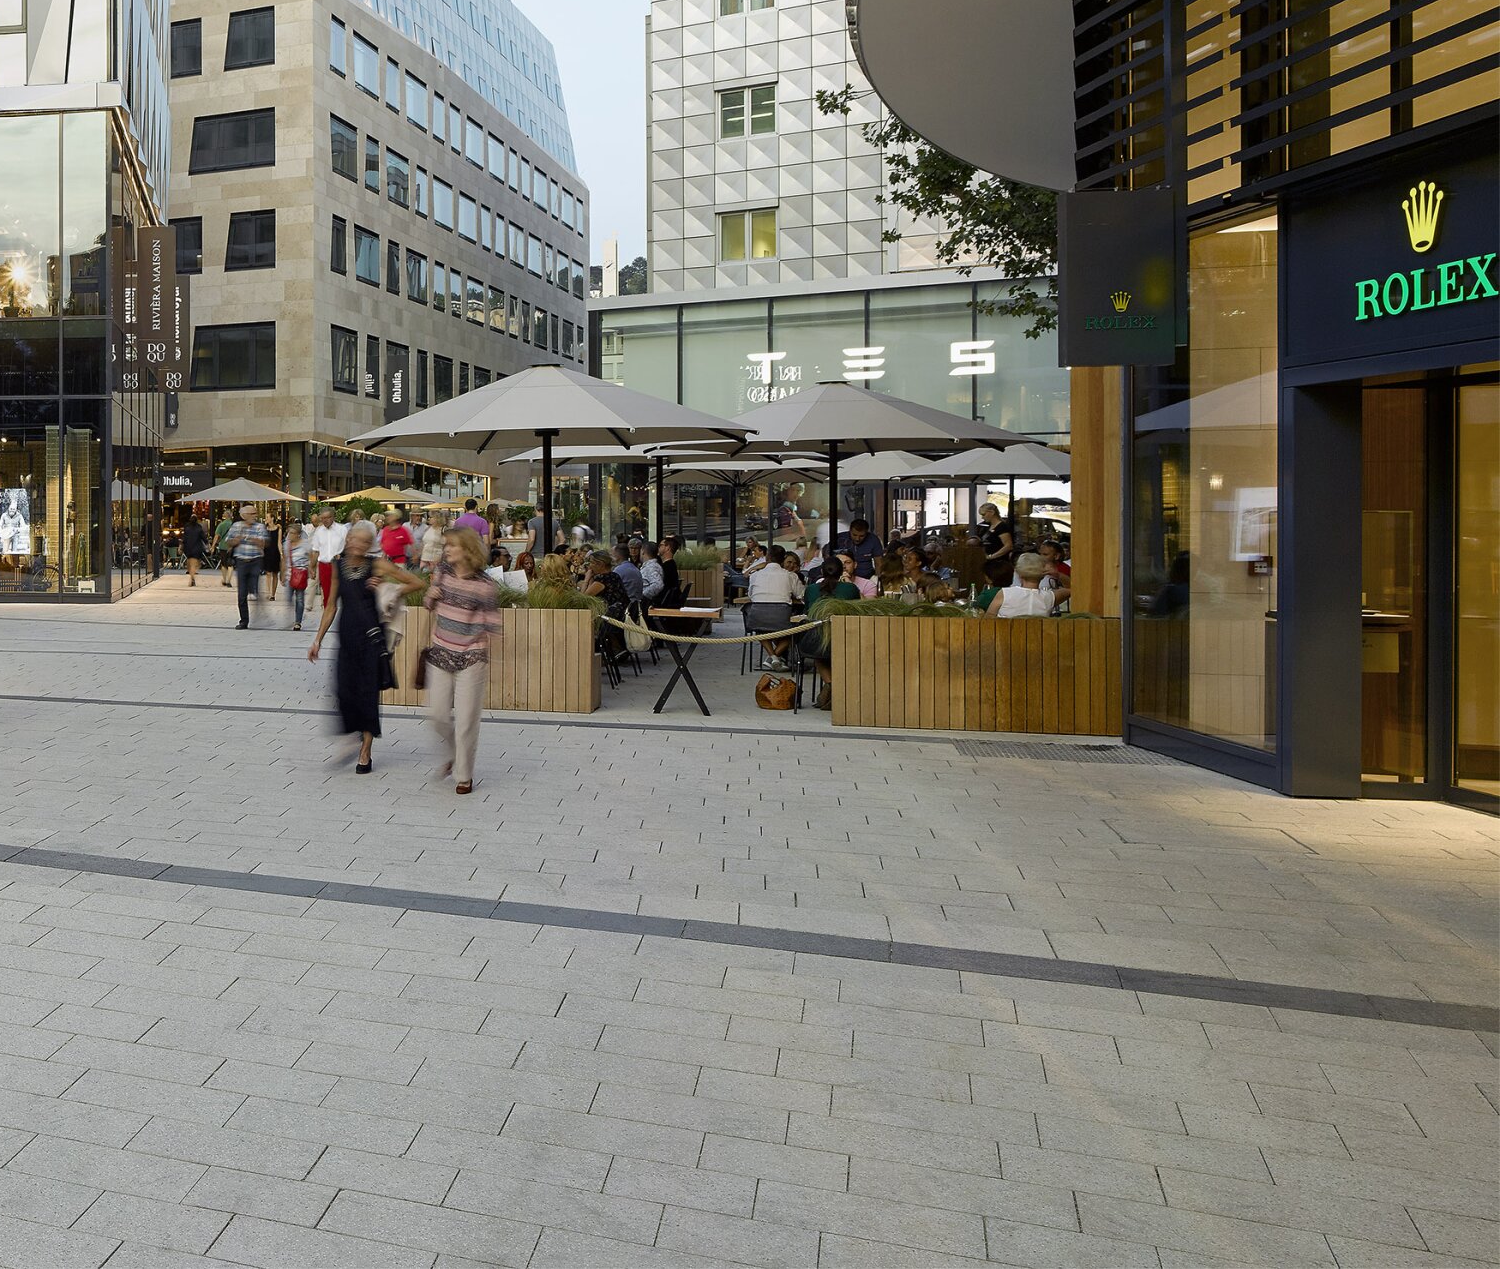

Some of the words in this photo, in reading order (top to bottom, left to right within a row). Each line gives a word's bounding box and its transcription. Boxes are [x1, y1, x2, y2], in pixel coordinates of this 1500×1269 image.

[153, 239, 161, 282] MAISON
[1355, 252, 1499, 321] ROLEX
[150, 284, 161, 330] RIVIÈRA
[1085, 315, 1158, 330] ROLEX
[147, 343, 166, 353] DO
[147, 353, 166, 363] QU
[166, 380, 182, 388] QU
